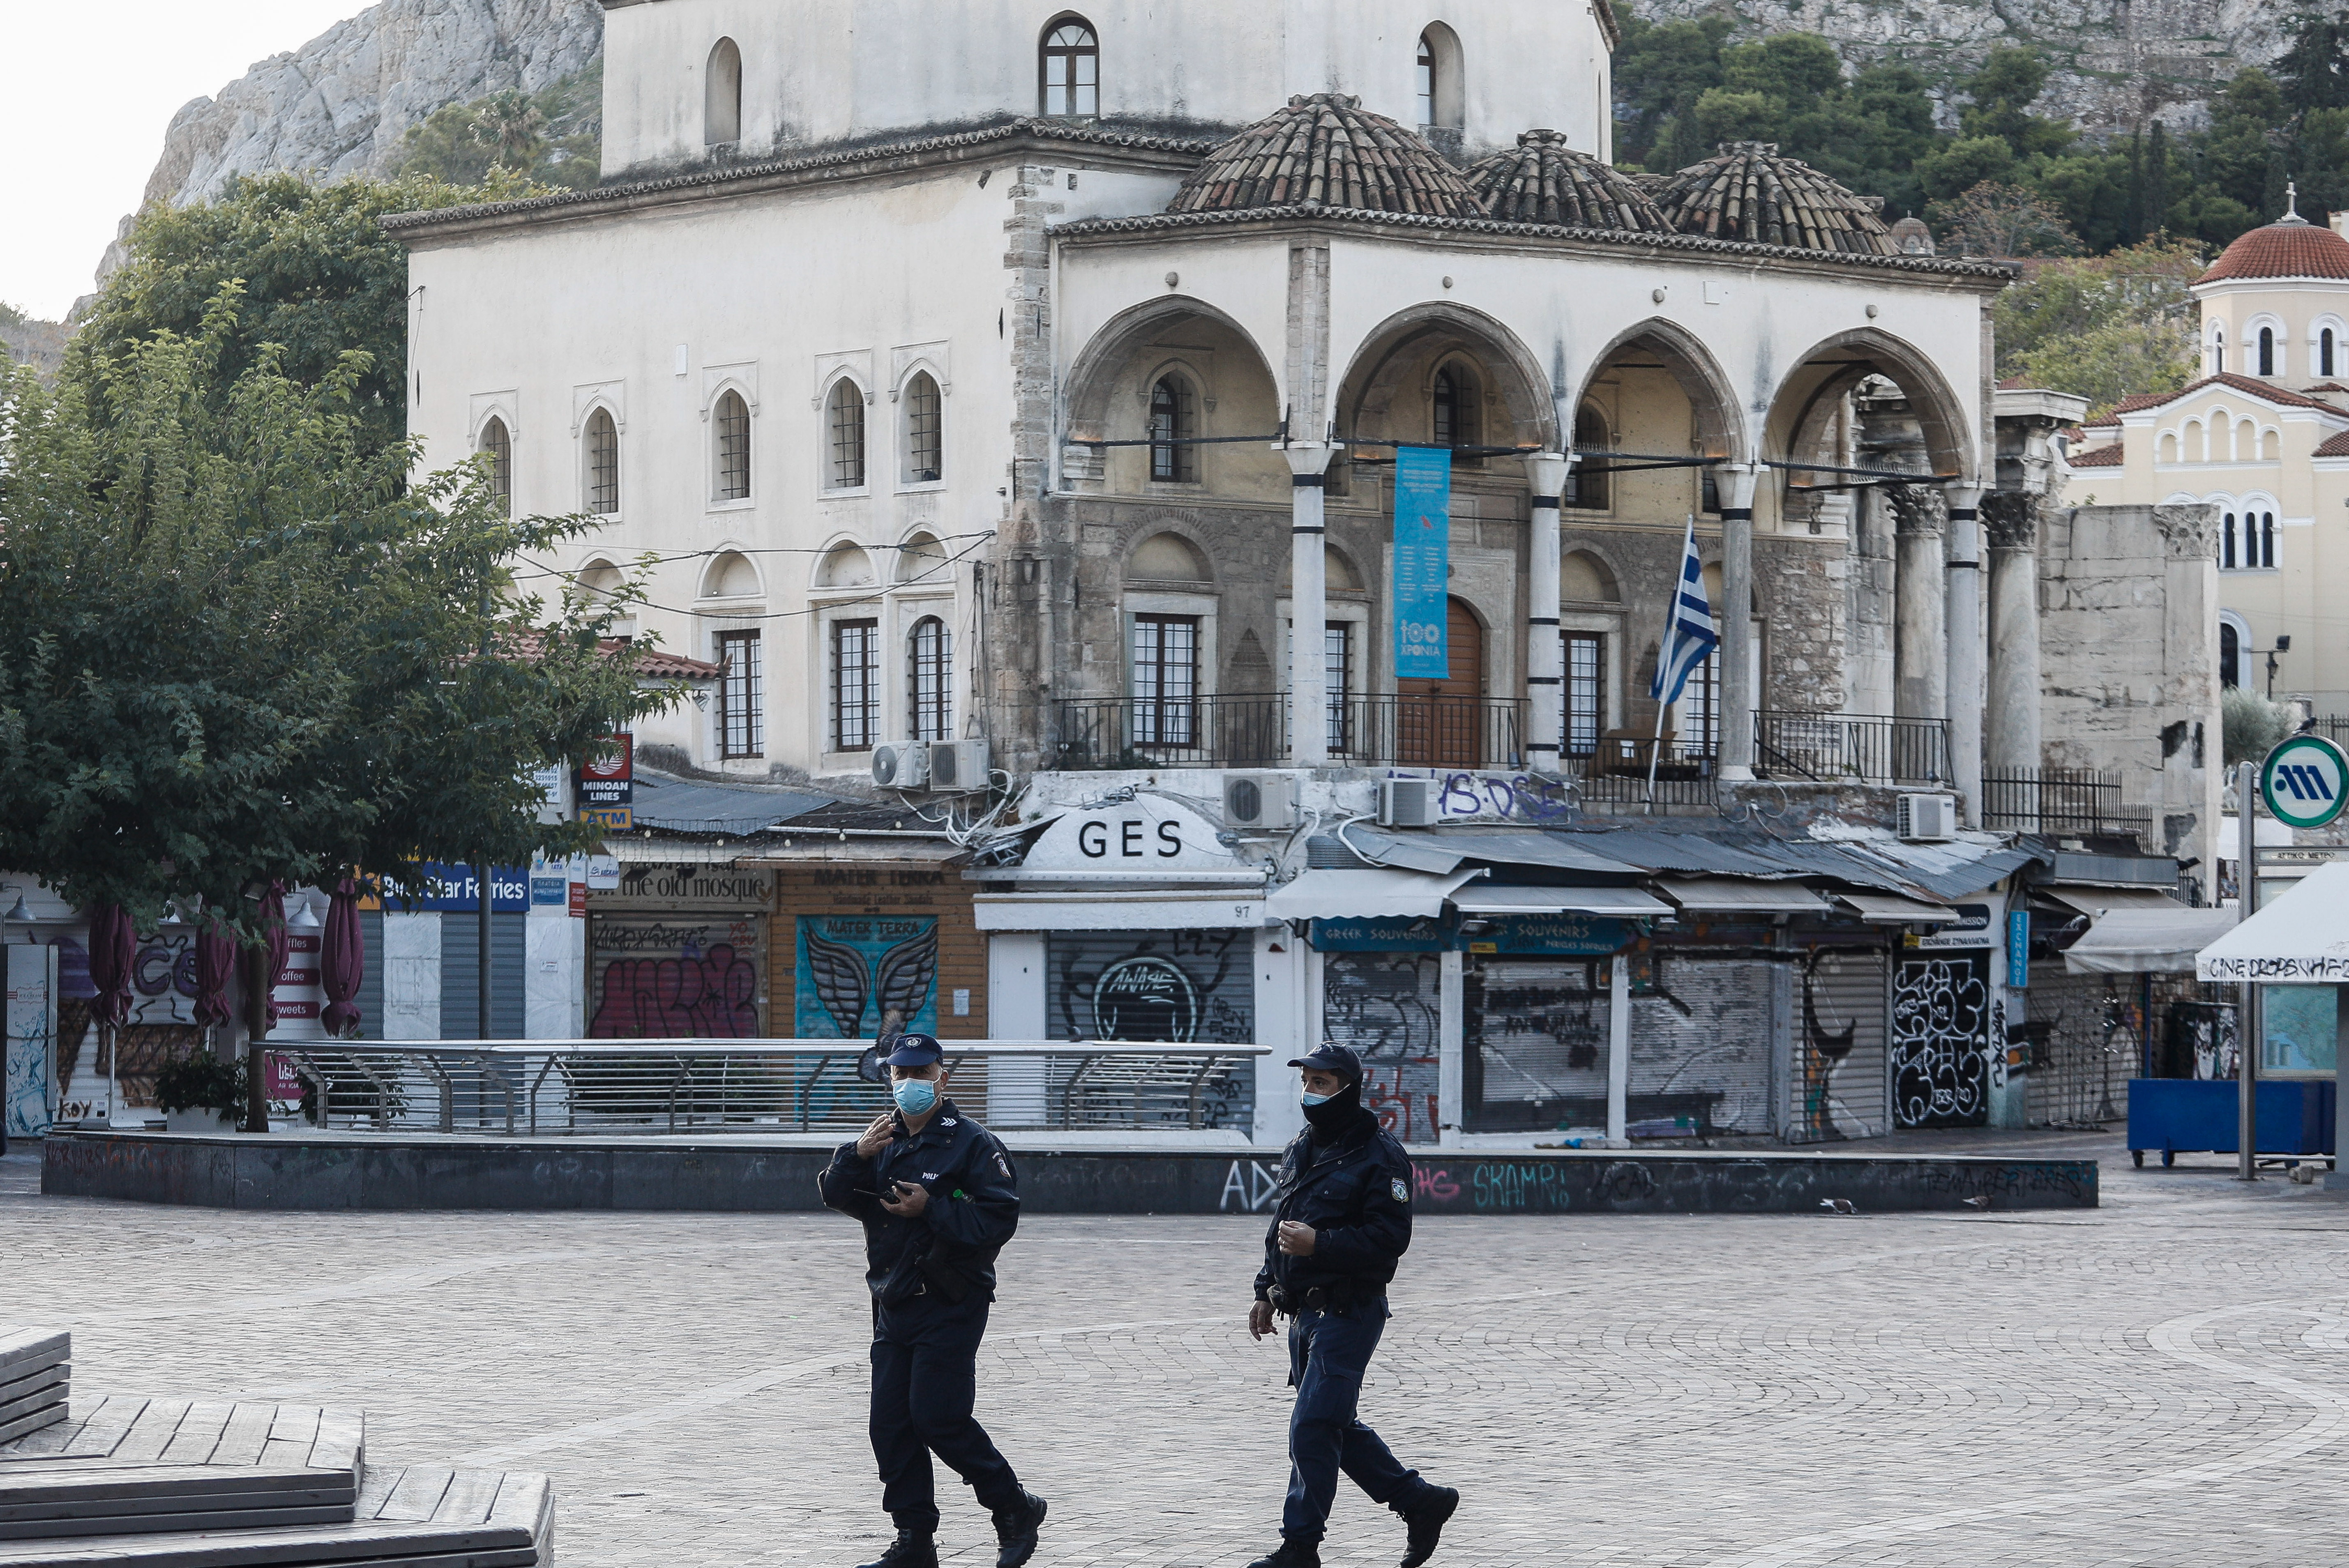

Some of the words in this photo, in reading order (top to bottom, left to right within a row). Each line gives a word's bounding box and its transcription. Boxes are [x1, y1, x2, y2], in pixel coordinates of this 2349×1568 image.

[583, 781, 629, 790] MINOAN
[590, 792, 620, 801] LINES
[587, 812, 626, 824] ATM
[1079, 821, 1182, 858] GES
[466, 877, 524, 899] Feries
[657, 870, 687, 896] old
[694, 877, 765, 901] mosque
[1235, 906, 1249, 918] 97
[827, 920, 871, 934] MATER
[876, 921, 920, 934] TERRA
[1517, 924, 1590, 938] SOUVENIRS
[1325, 928, 1362, 940] GREEK
[1370, 928, 1436, 940] SOUVENIRS
[288, 939, 307, 948] ffles
[281, 972, 304, 981] offee
